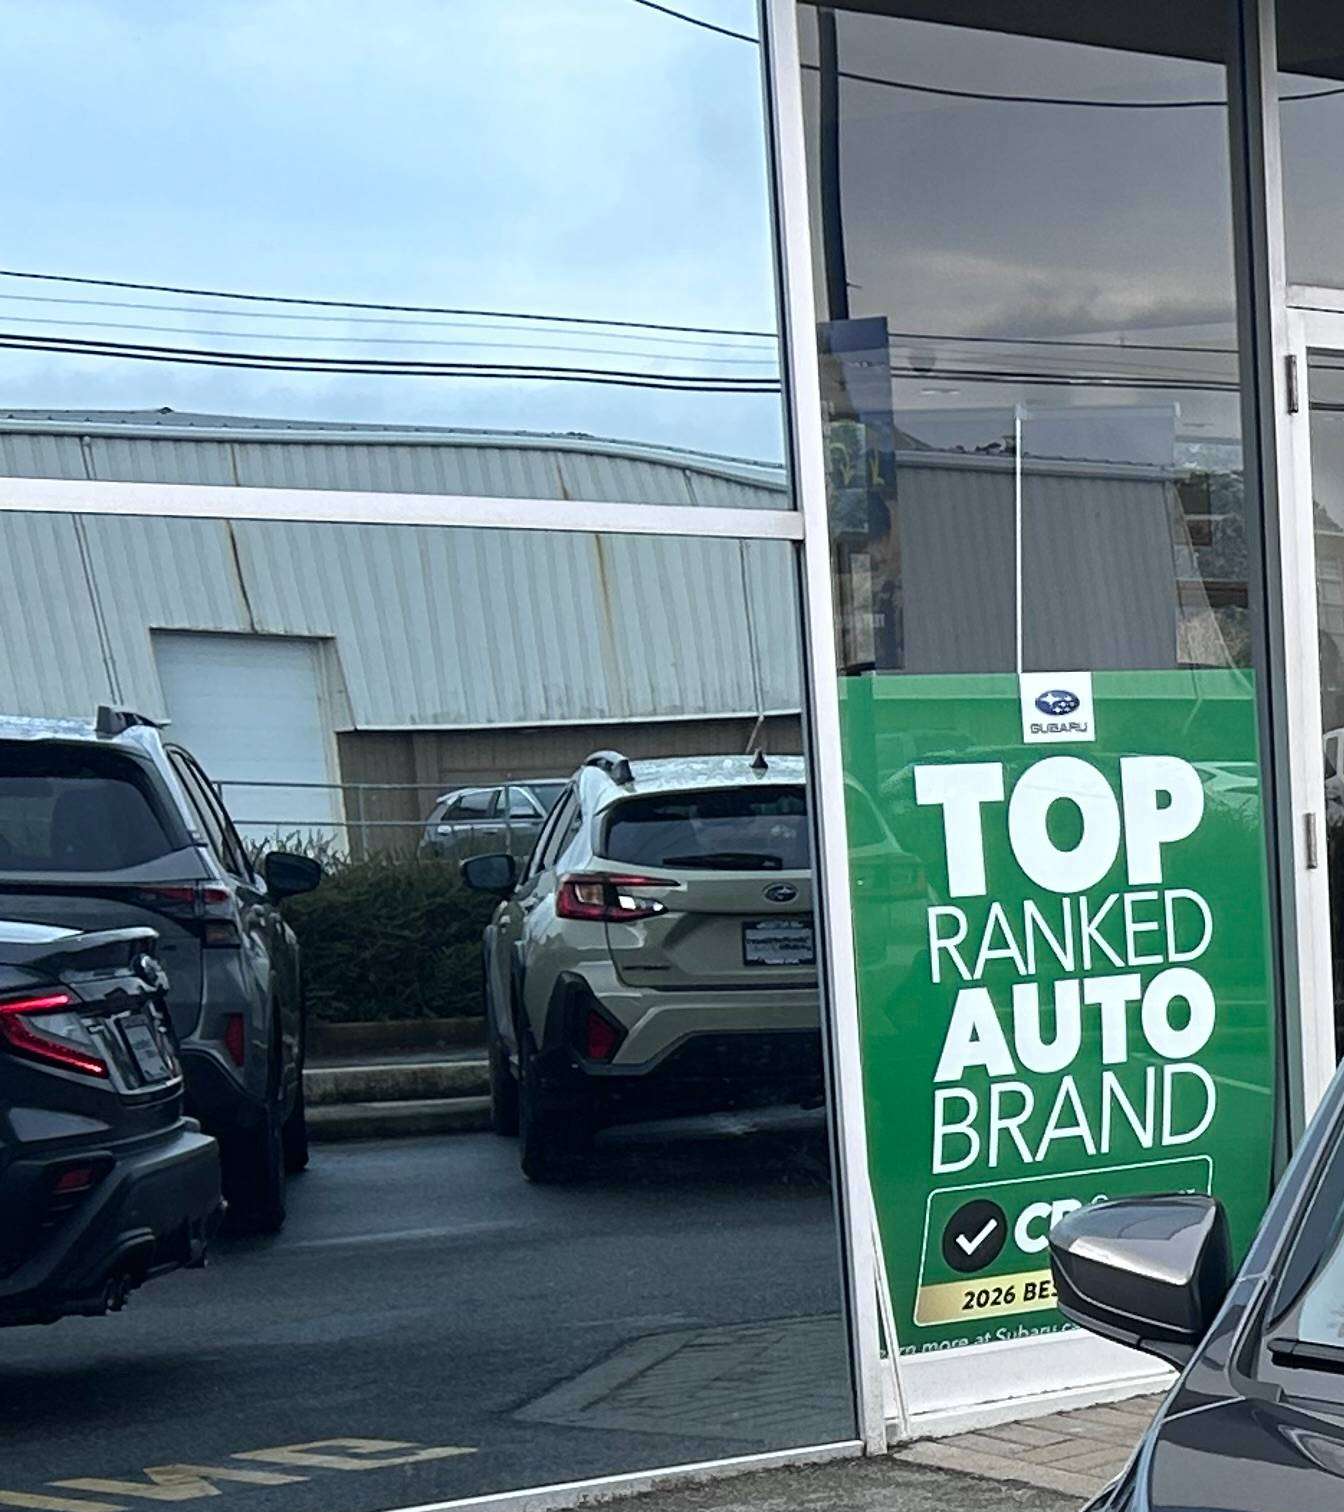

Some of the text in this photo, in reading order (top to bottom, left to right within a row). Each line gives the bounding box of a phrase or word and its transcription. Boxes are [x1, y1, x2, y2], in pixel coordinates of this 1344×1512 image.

[1030, 721, 1088, 734] SUBARU
[914, 755, 1205, 897] TOP
[927, 888, 1214, 984] RANKED
[933, 967, 1216, 1083] AUTO
[932, 1063, 1217, 1175] BRAND
[962, 1285, 1016, 1310] 2026
